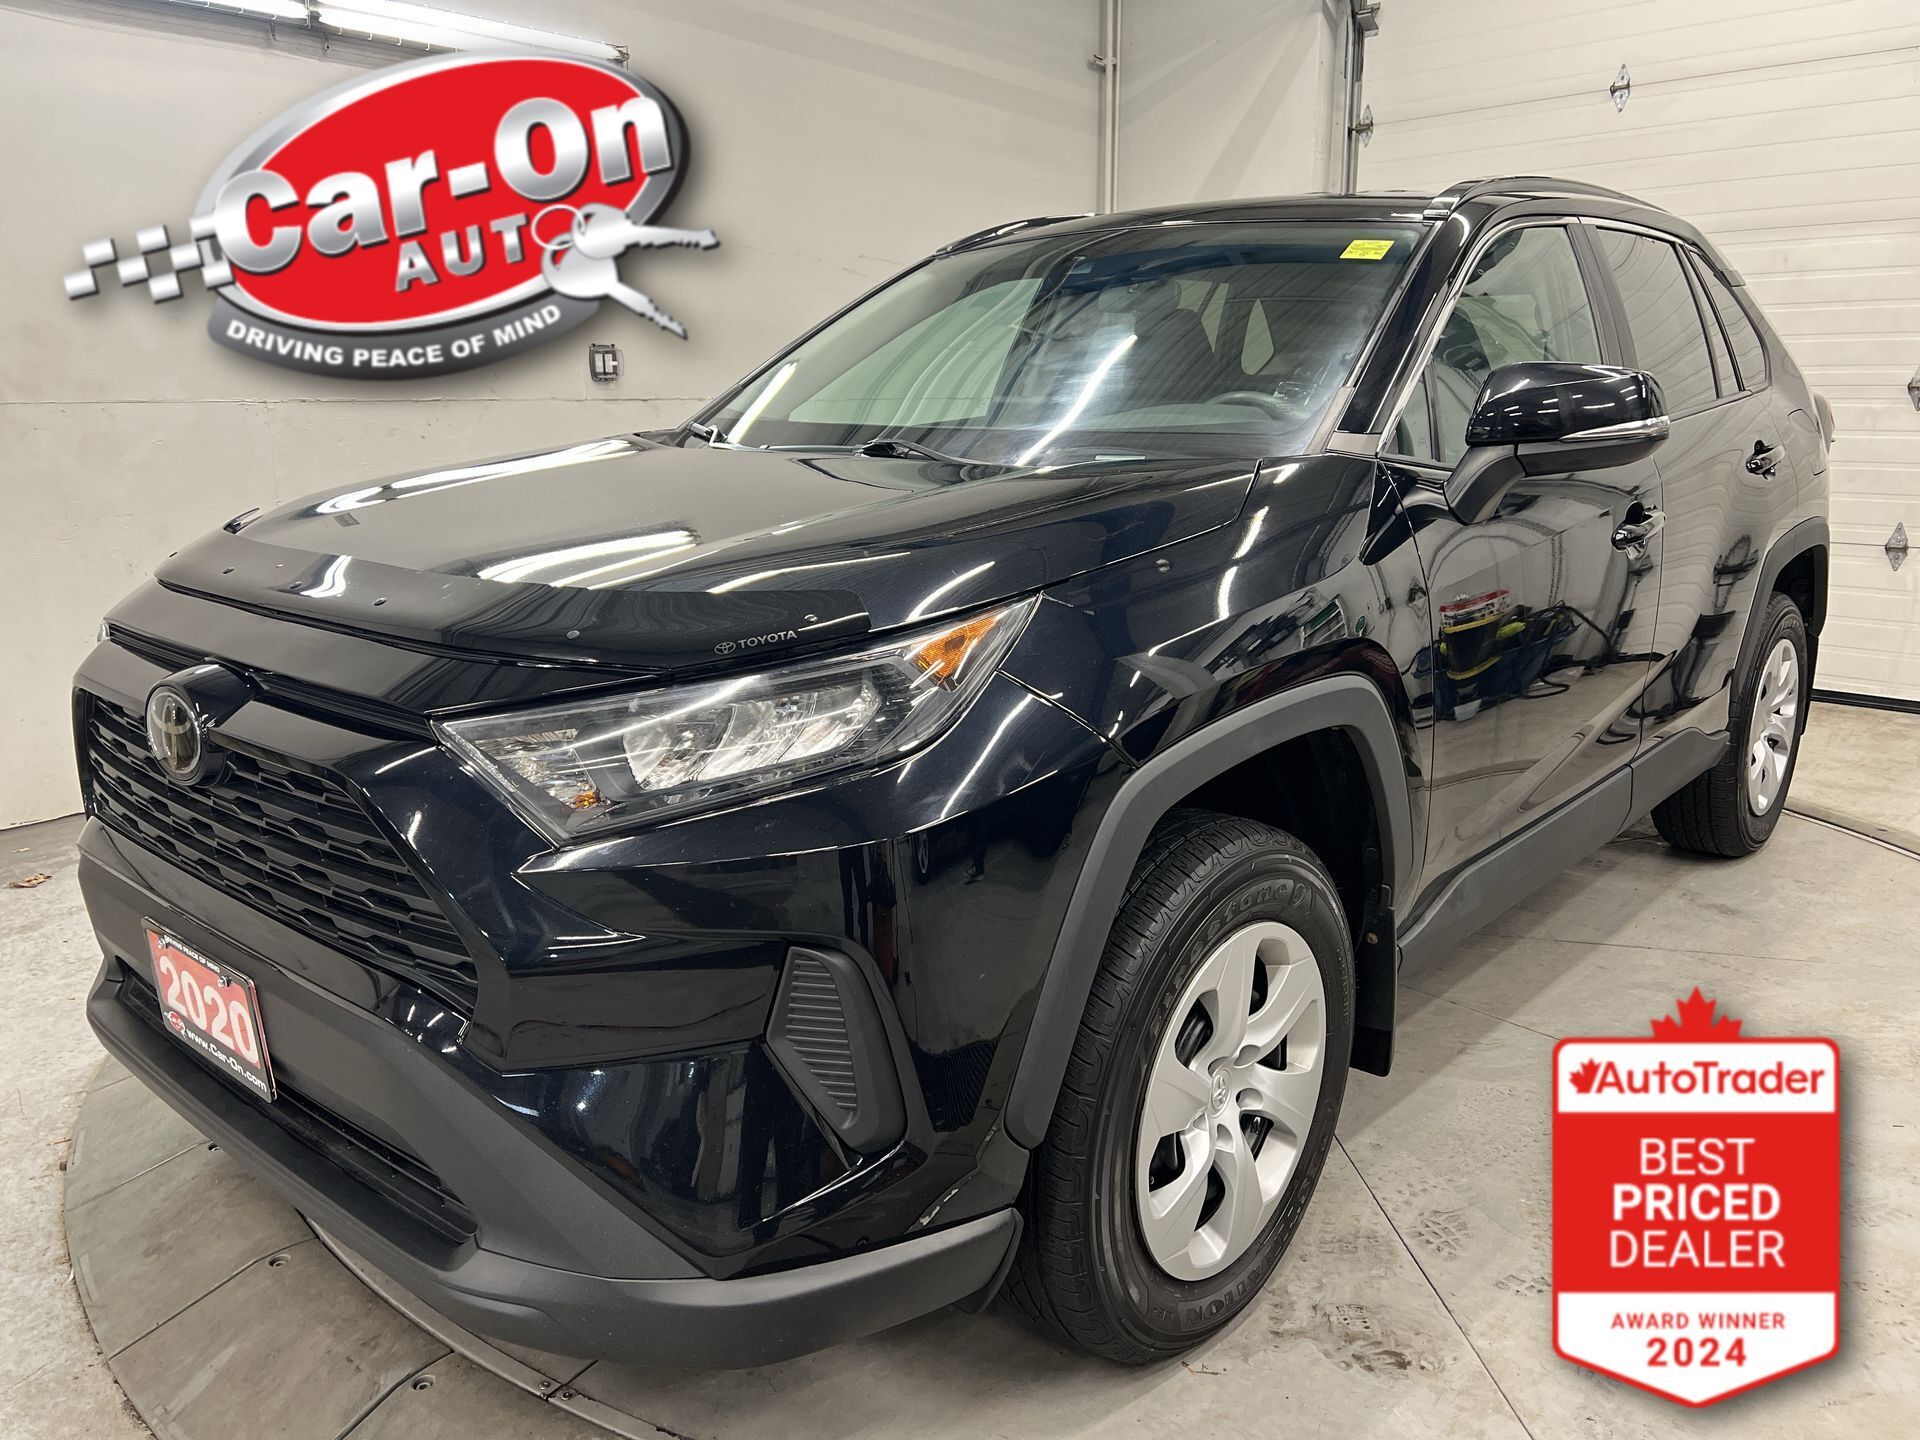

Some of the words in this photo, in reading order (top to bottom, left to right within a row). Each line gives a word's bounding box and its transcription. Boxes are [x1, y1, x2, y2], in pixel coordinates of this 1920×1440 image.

[738, 630, 798, 649] TOYOTA
[159, 955, 259, 1064] 2020
[186, 1028, 268, 1093] www.Car-On.com
